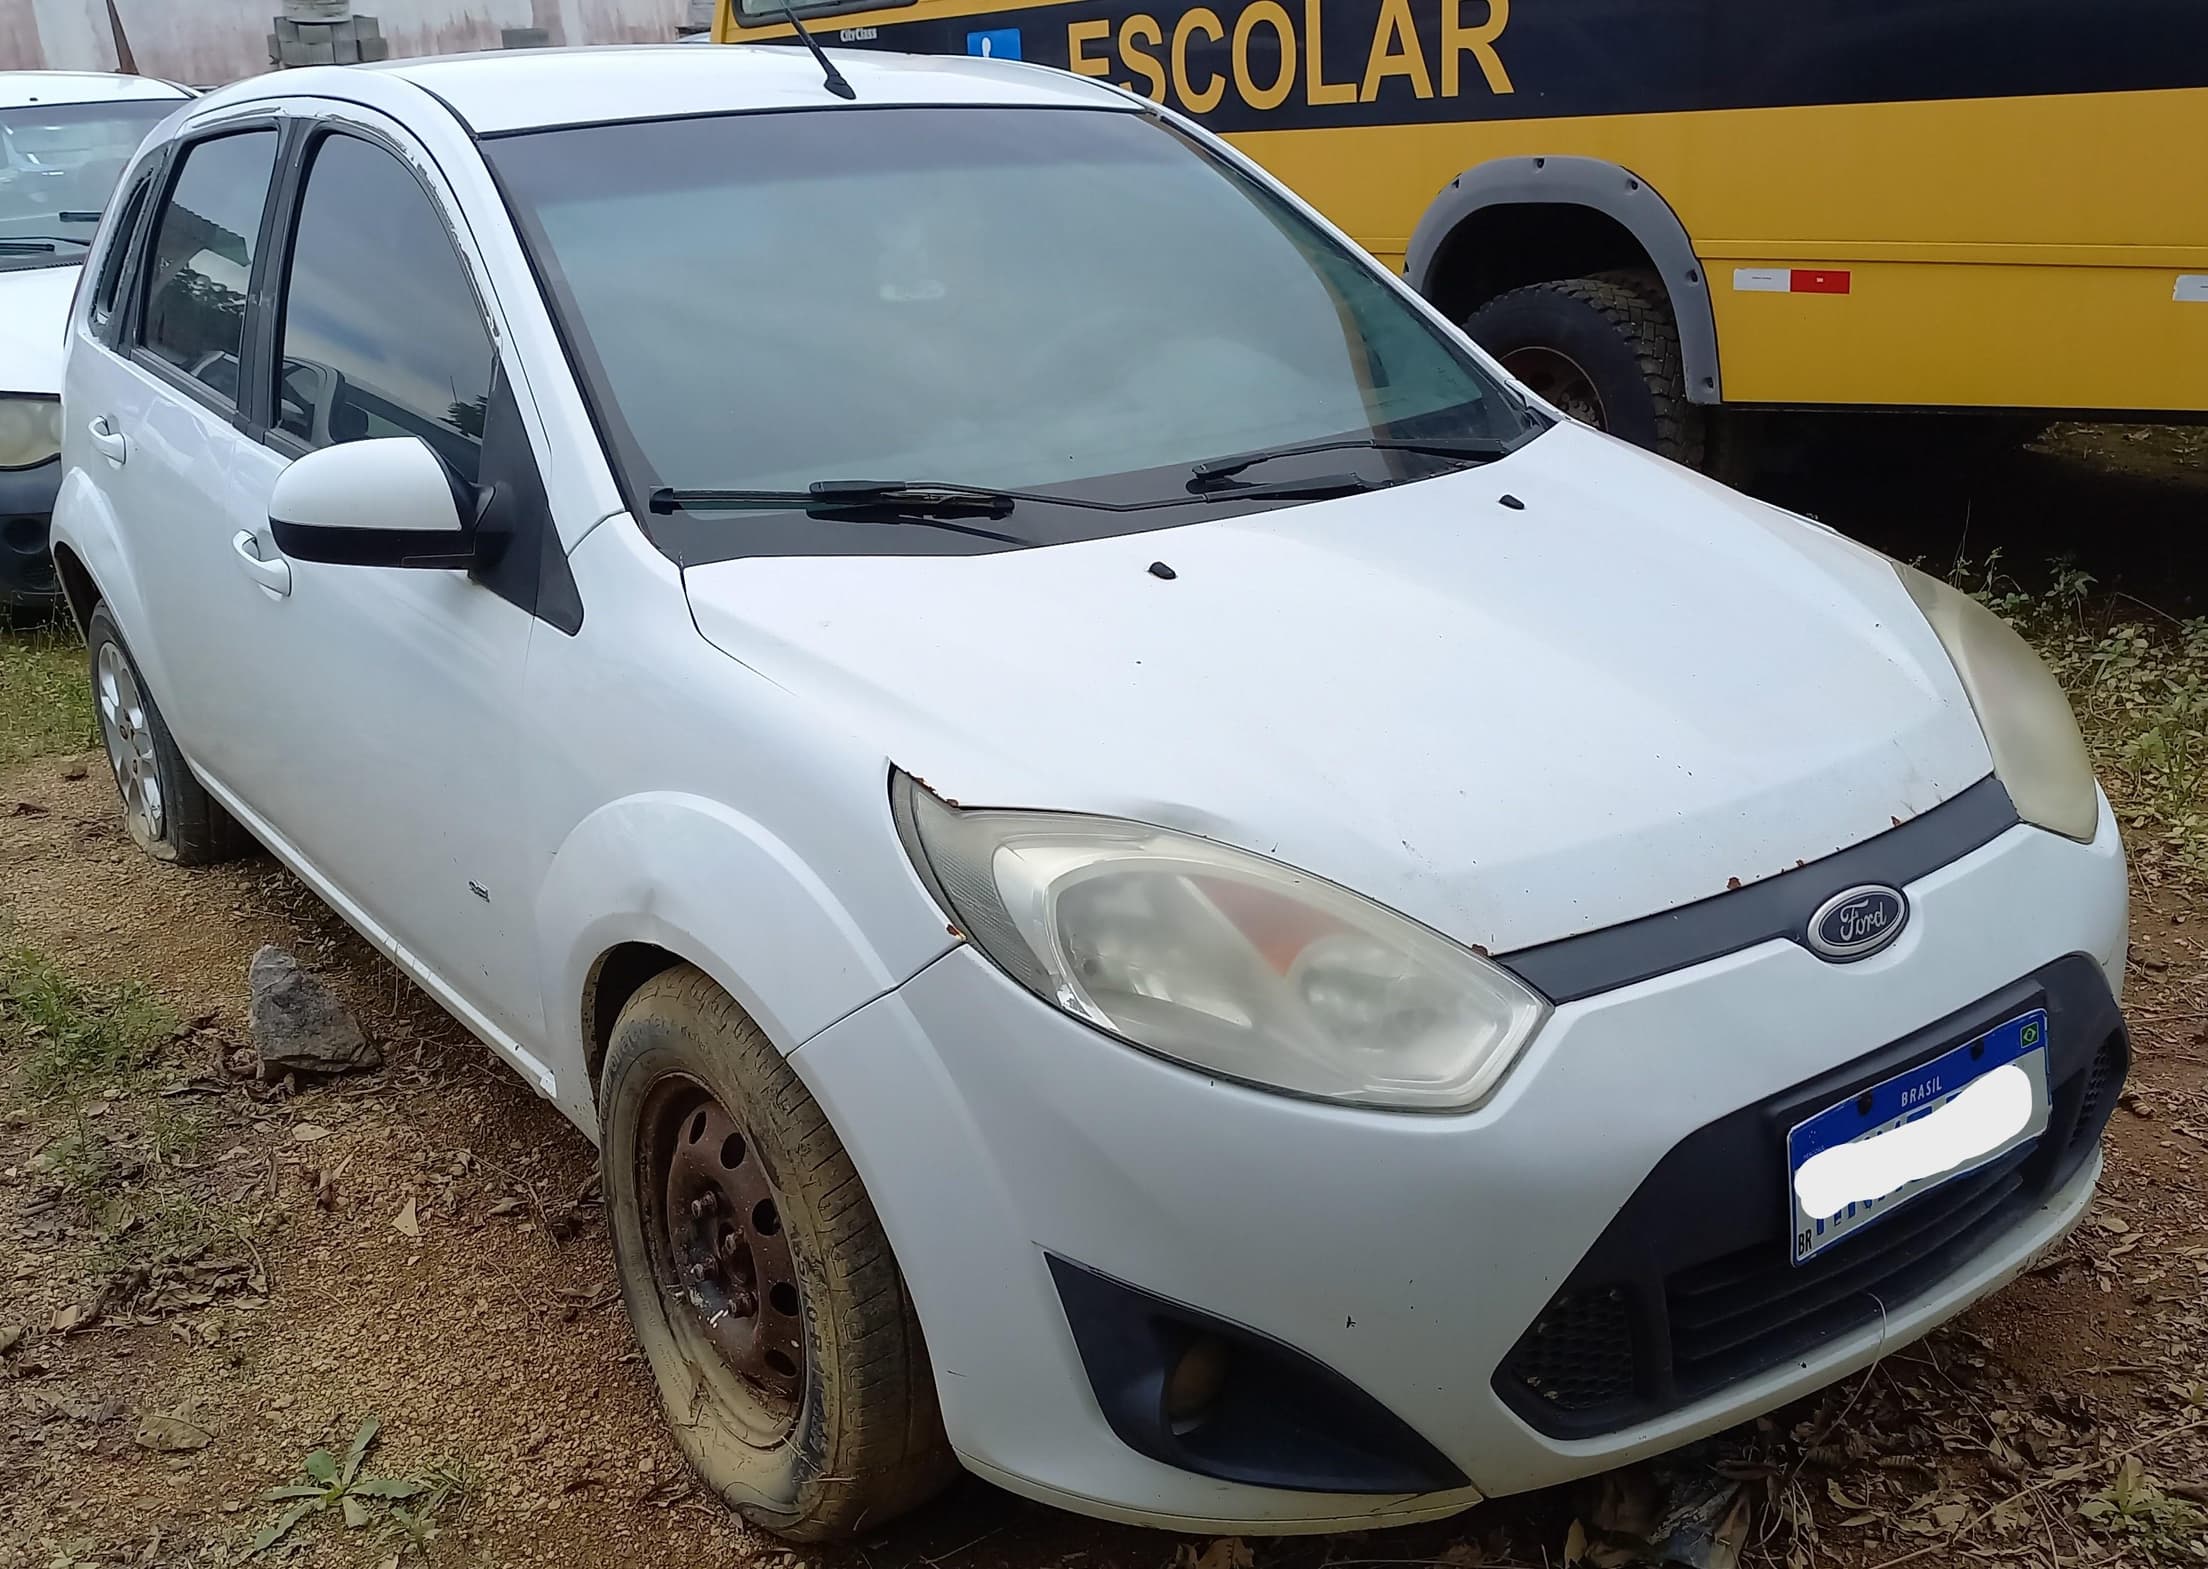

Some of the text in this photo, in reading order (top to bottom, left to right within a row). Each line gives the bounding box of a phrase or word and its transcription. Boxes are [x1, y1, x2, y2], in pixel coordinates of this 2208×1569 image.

[1067, 0, 1515, 114] ESCOLAR
[1839, 898, 1888, 941] Ford
[1901, 1075, 1943, 1107] BRASIL
[1798, 1228, 1812, 1256] BR
